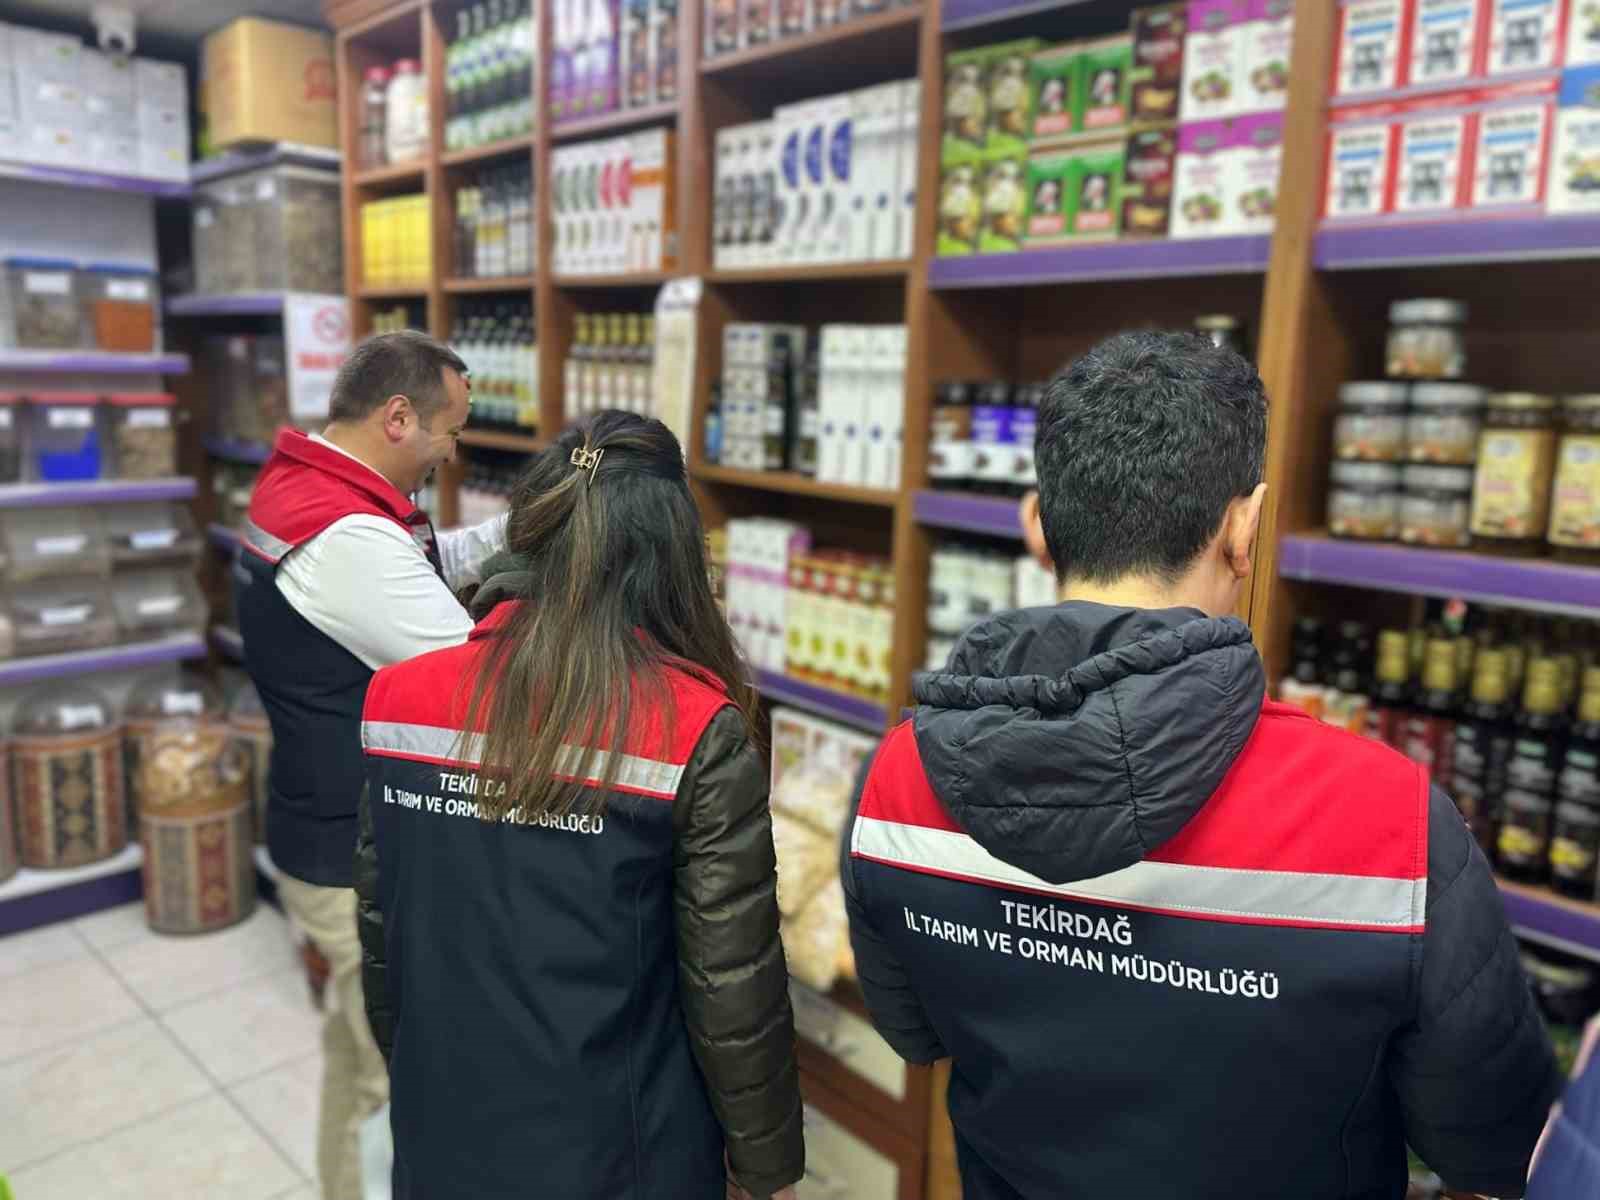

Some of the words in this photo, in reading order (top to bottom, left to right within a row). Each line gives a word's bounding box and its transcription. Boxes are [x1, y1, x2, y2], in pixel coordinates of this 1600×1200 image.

[384, 785, 395, 803] İL
[396, 790, 422, 811] TARIM
[425, 795, 443, 813] VE
[1000, 900, 1132, 946] TEKİRDAĞ
[904, 906, 921, 933] İL
[921, 915, 979, 948] TARIM
[983, 929, 1013, 955] VE
[1018, 938, 1104, 973] ORMAN
[1112, 954, 1280, 1000] MÜDÜRLÜĞÜ
